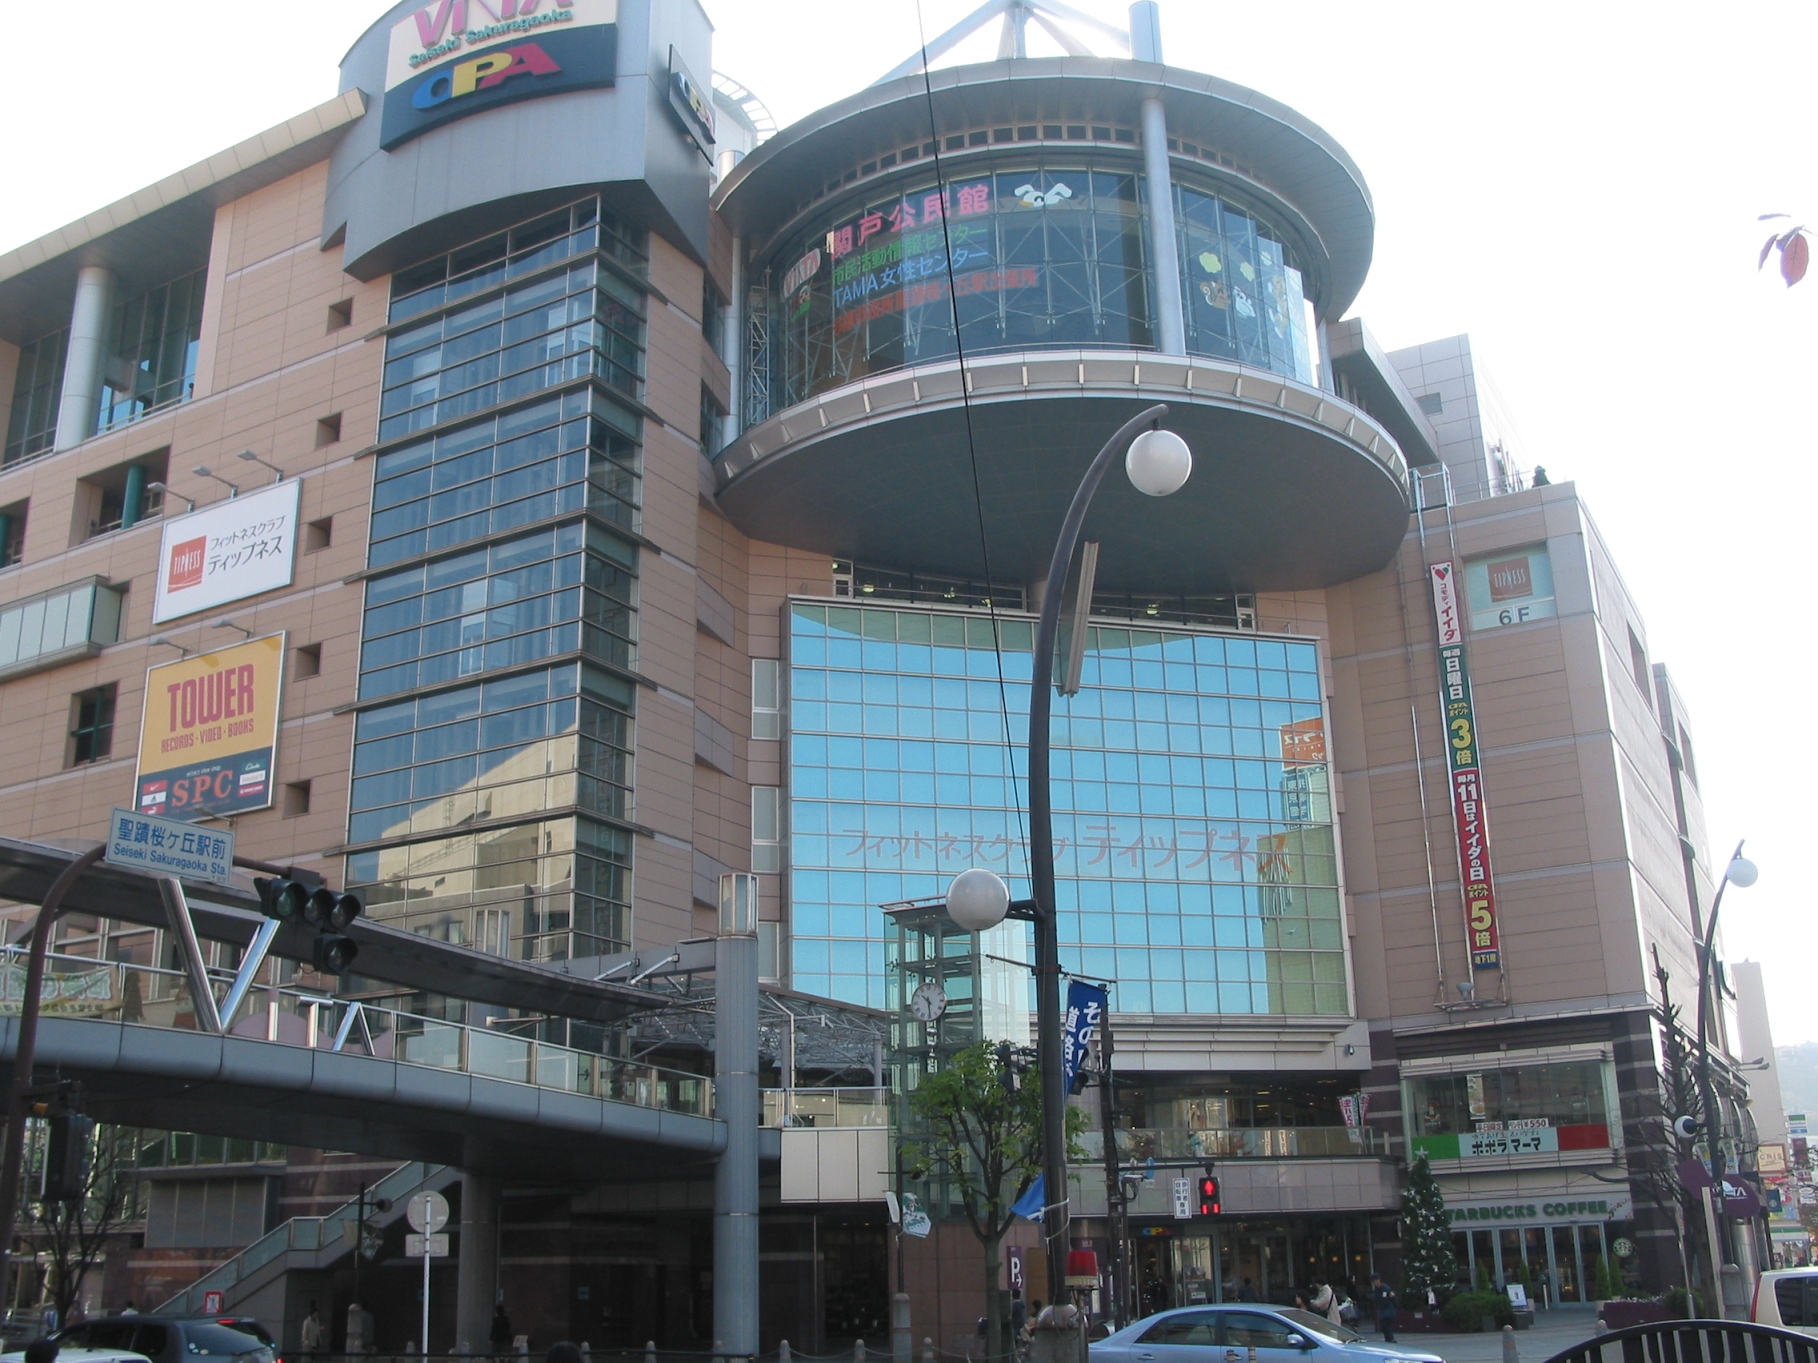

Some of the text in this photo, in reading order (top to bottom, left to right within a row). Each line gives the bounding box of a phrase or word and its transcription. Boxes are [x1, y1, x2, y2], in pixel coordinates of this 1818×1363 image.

[408, 8, 574, 68] Seiseki Sakuragaoka
[411, 42, 563, 110] OPA
[679, 72, 716, 138] OPA
[831, 183, 990, 262] 関戸公民館
[210, 515, 286, 551] フィットネスクラブ
[208, 535, 283, 575] ティップネス
[1494, 566, 1526, 588] TIPNESS
[167, 663, 255, 734] TOWER
[160, 718, 254, 754] RECORDS VIDEO BOOKS
[171, 769, 233, 807] SPC
[113, 843, 226, 876] Seiseki Sakuragaoka Sta.
[1082, 825, 1293, 873] ティップネス
[1445, 1200, 1608, 1223] TARBUCKS COFFEE
[1142, 1227, 1171, 1236] OPA
[1011, 1256, 1020, 1283] P
